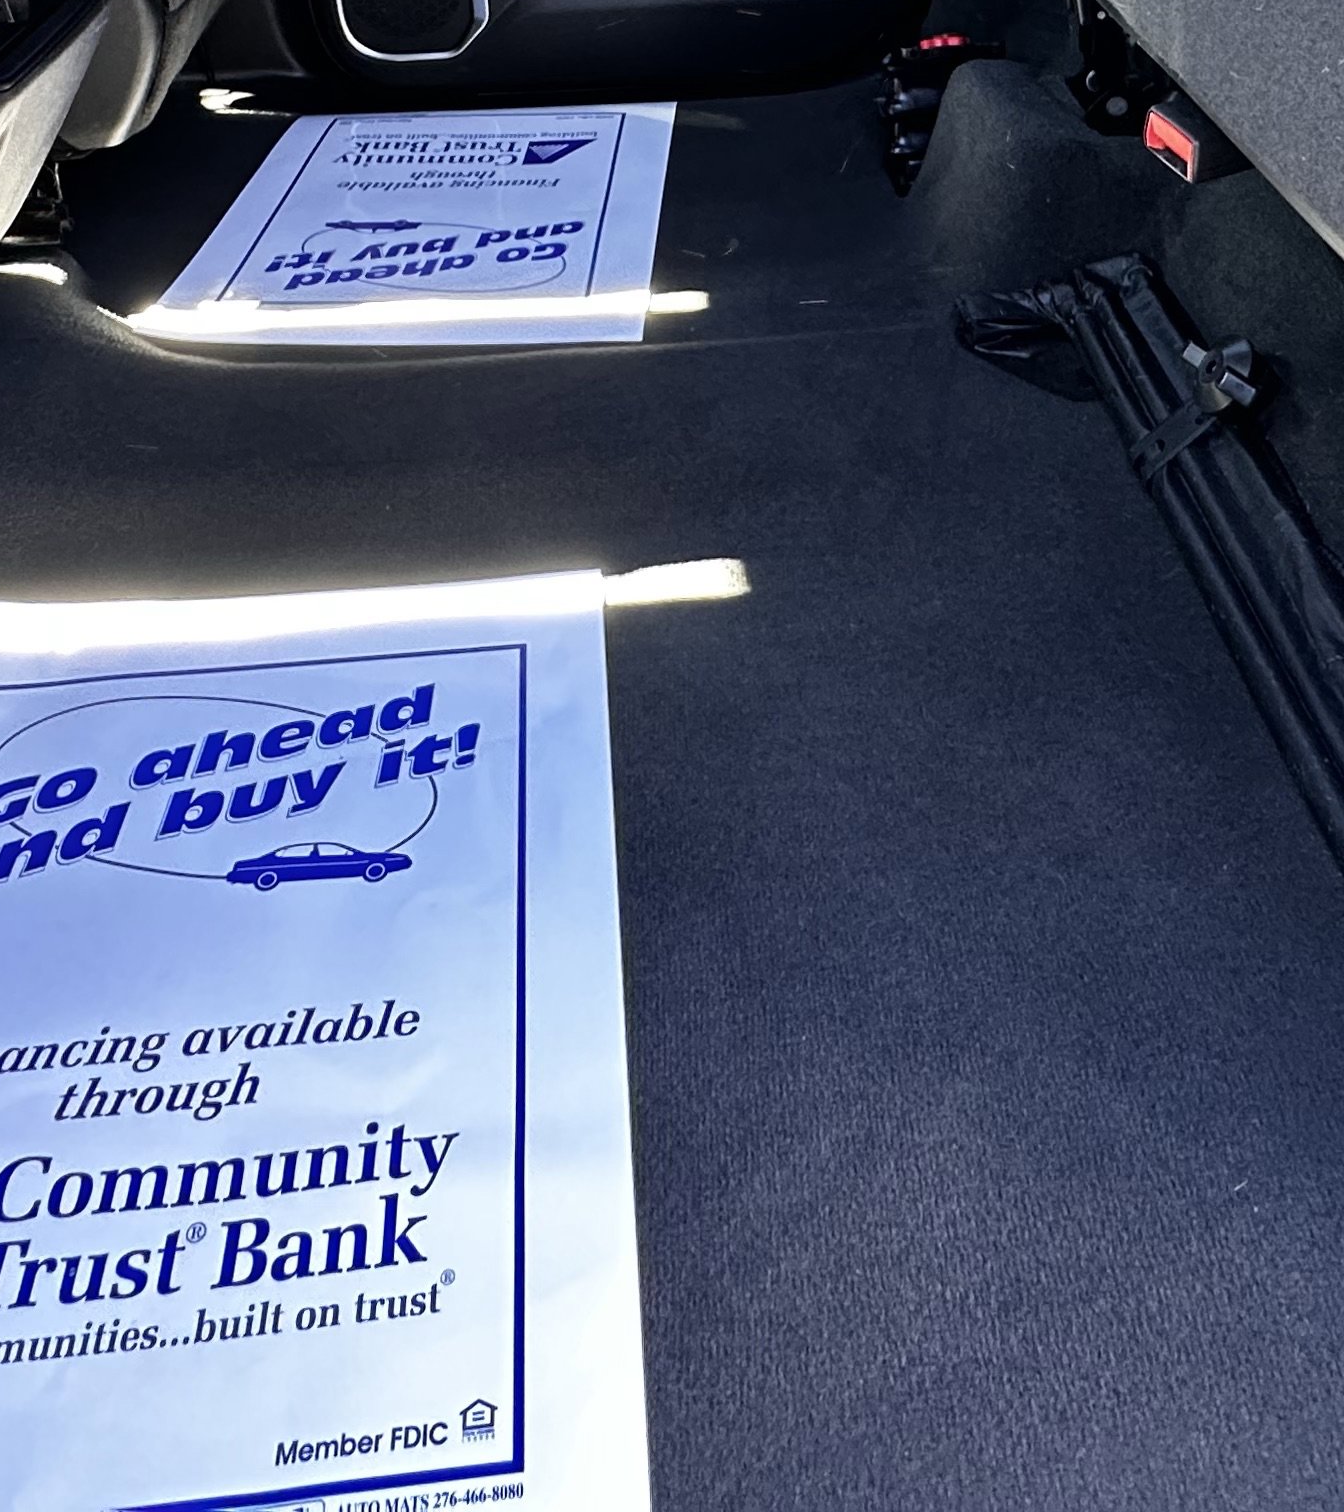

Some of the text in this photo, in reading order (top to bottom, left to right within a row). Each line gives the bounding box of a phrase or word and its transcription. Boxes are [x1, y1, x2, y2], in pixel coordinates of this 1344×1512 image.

[332, 151, 518, 167] Community
[354, 141, 430, 153] Bank
[336, 178, 561, 192] Financing available
[409, 170, 496, 181] through
[264, 220, 585, 273] and buy it!
[283, 242, 568, 291] Go ahead
[129, 683, 436, 791] ahead
[154, 759, 347, 841] buy
[374, 722, 482, 788] it!
[181, 999, 422, 1057] available
[54, 1062, 262, 1123] through
[210, 1192, 430, 1292] Bank
[294, 1305, 342, 1333] on
[274, 1431, 385, 1467] Member
[389, 1421, 449, 1452] FDIC
[385, 1493, 430, 1512] MATS
[433, 1482, 525, 1509] 276-466-8080
